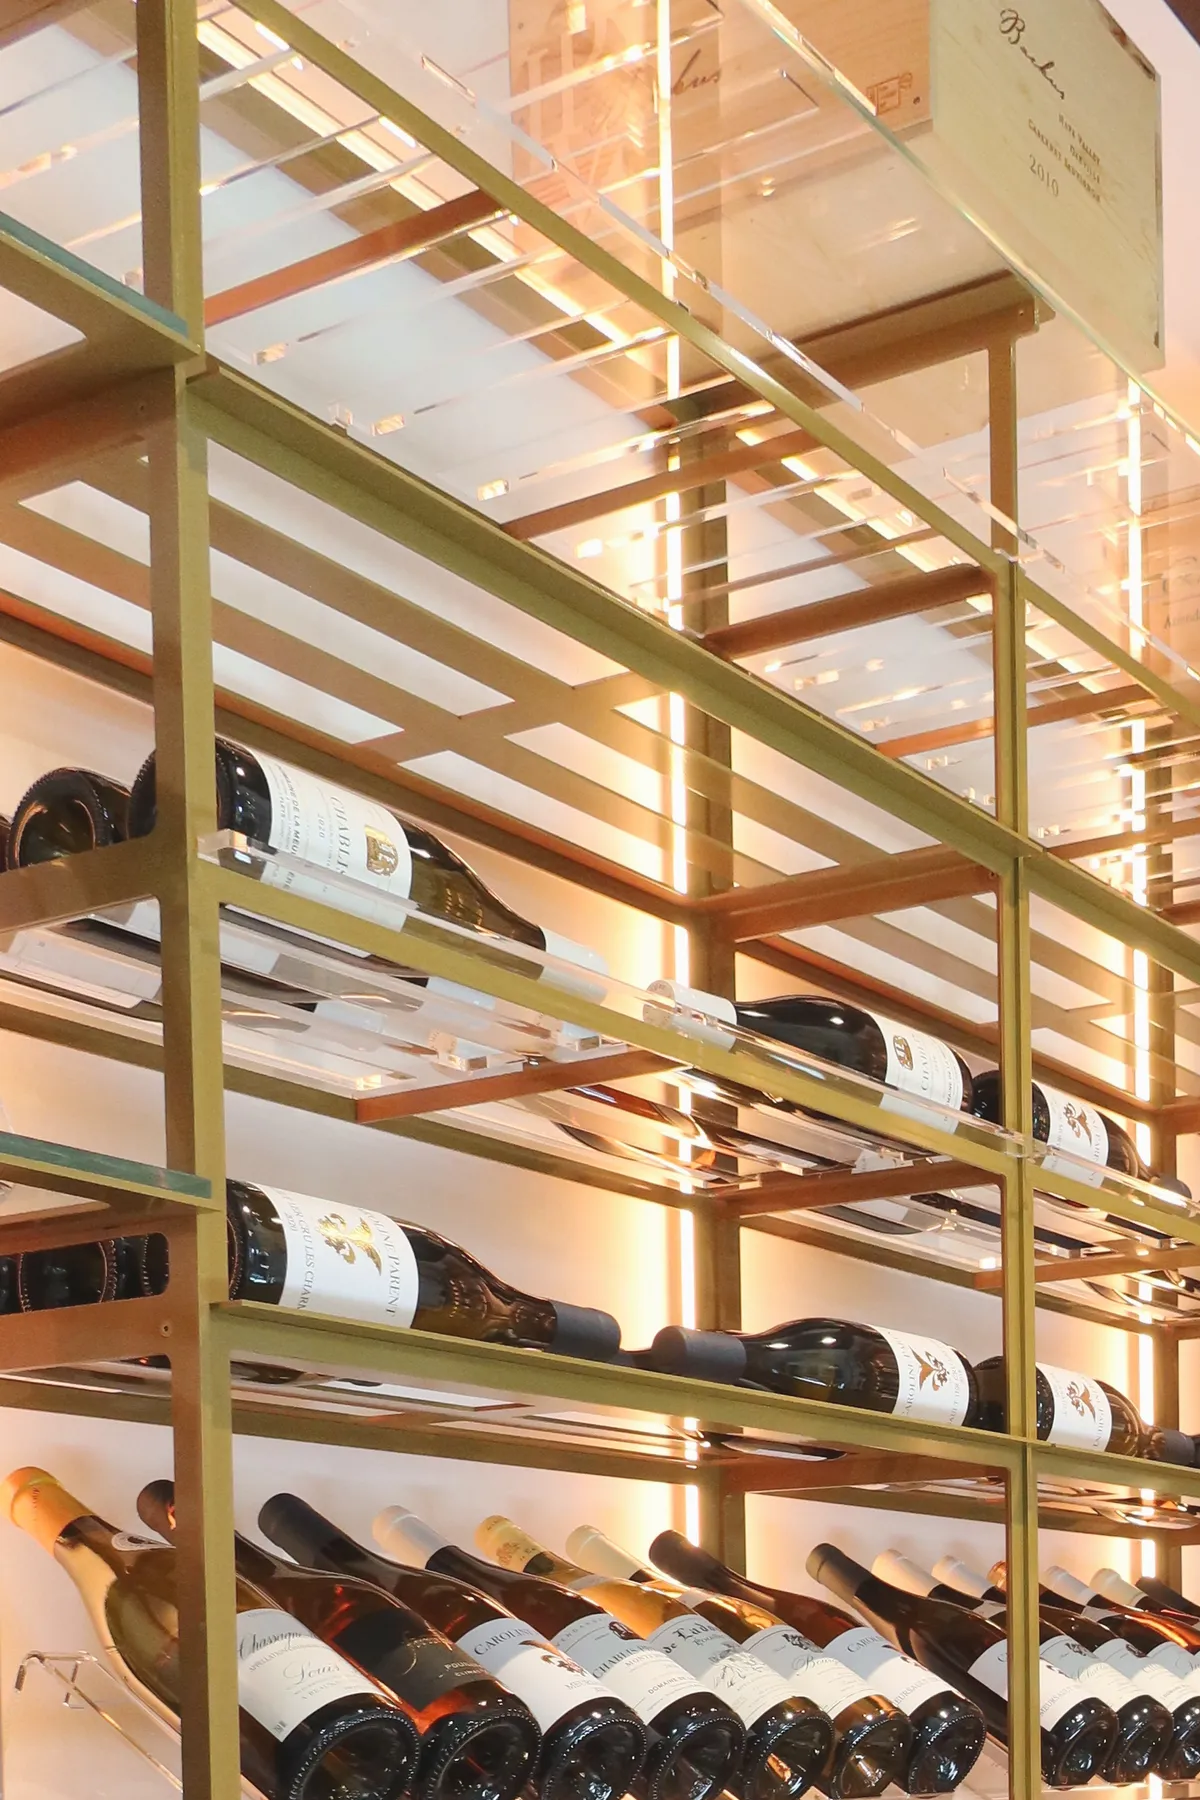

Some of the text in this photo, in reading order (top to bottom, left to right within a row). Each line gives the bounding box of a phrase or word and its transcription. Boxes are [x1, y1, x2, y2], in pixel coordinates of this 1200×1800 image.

[1029, 154, 1059, 197] 2010
[386, 1254, 401, 1317] PARENT
[592, 1645, 640, 1680] CHABLIS
